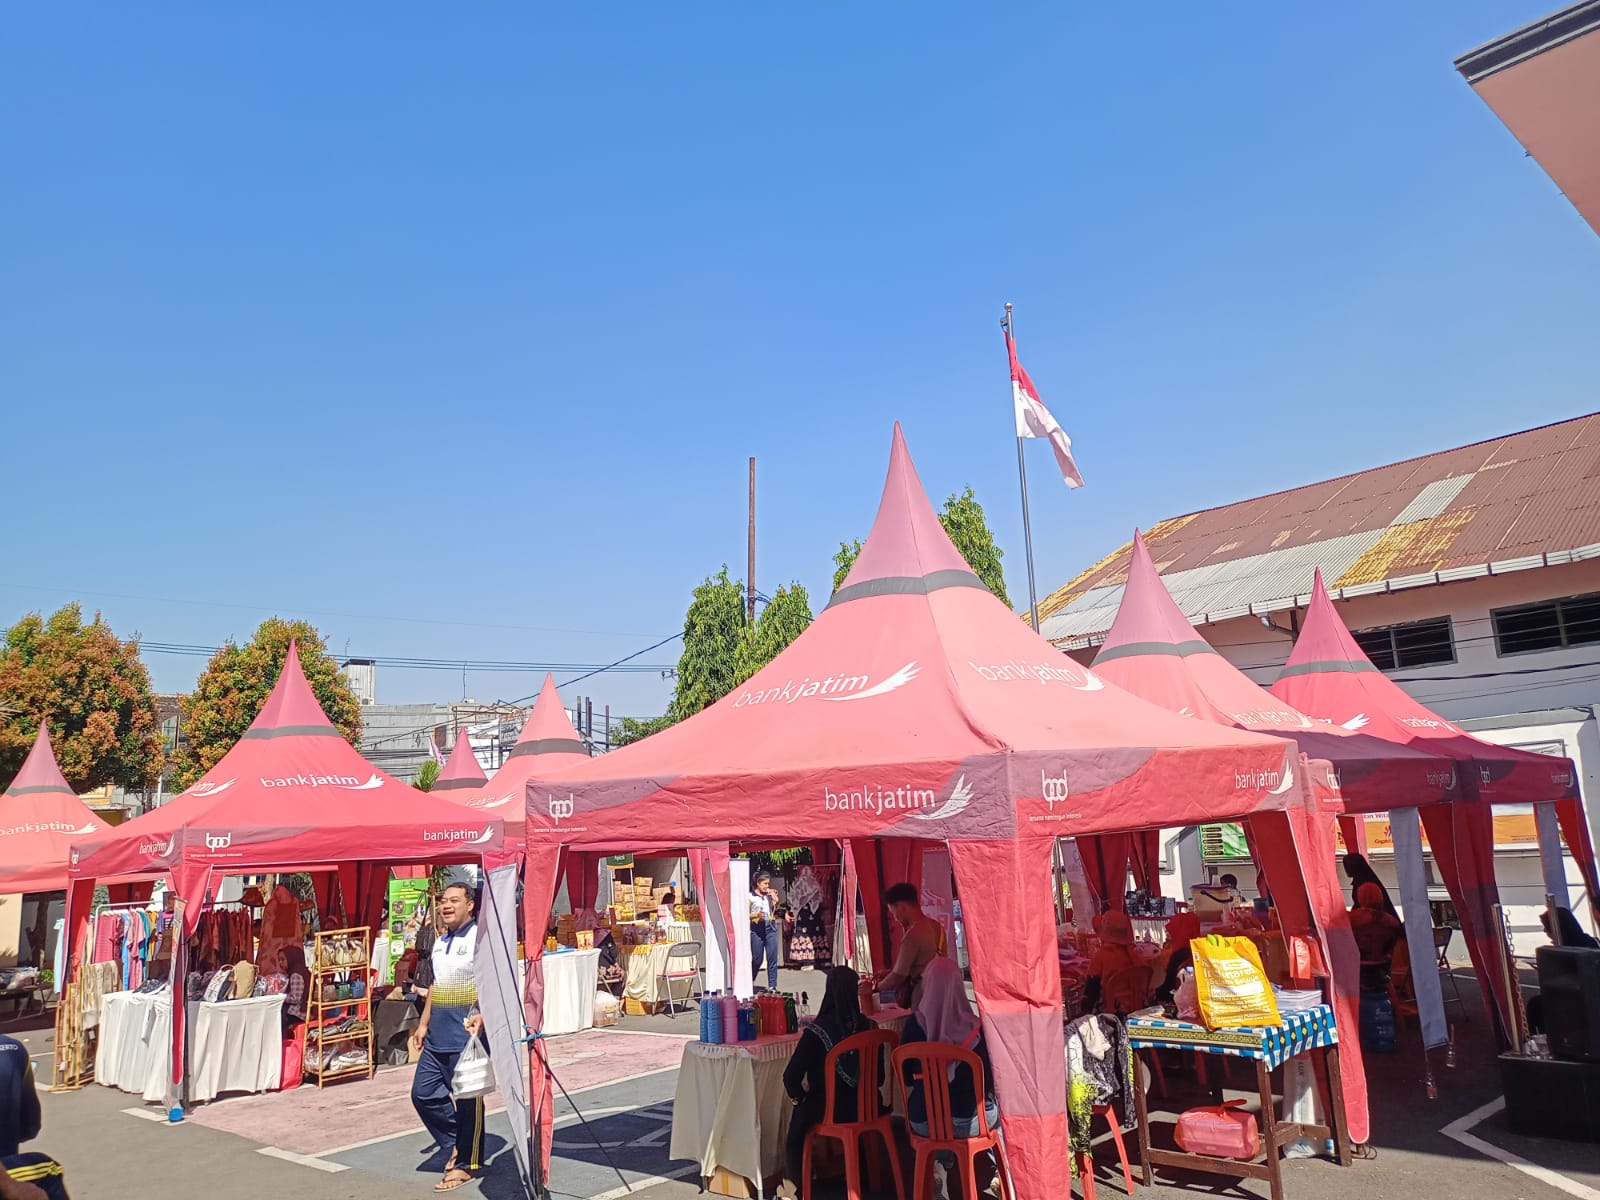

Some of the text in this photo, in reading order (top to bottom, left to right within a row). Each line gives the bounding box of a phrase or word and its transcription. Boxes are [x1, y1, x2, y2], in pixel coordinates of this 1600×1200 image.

[970, 662, 1077, 685] bankjatim
[732, 673, 868, 708] bankjatim
[261, 773, 360, 789] bankjatim
[1235, 768, 1279, 793] bankjatim
[825, 784, 935, 815] bankjatim
[423, 828, 478, 842] bankjatim
